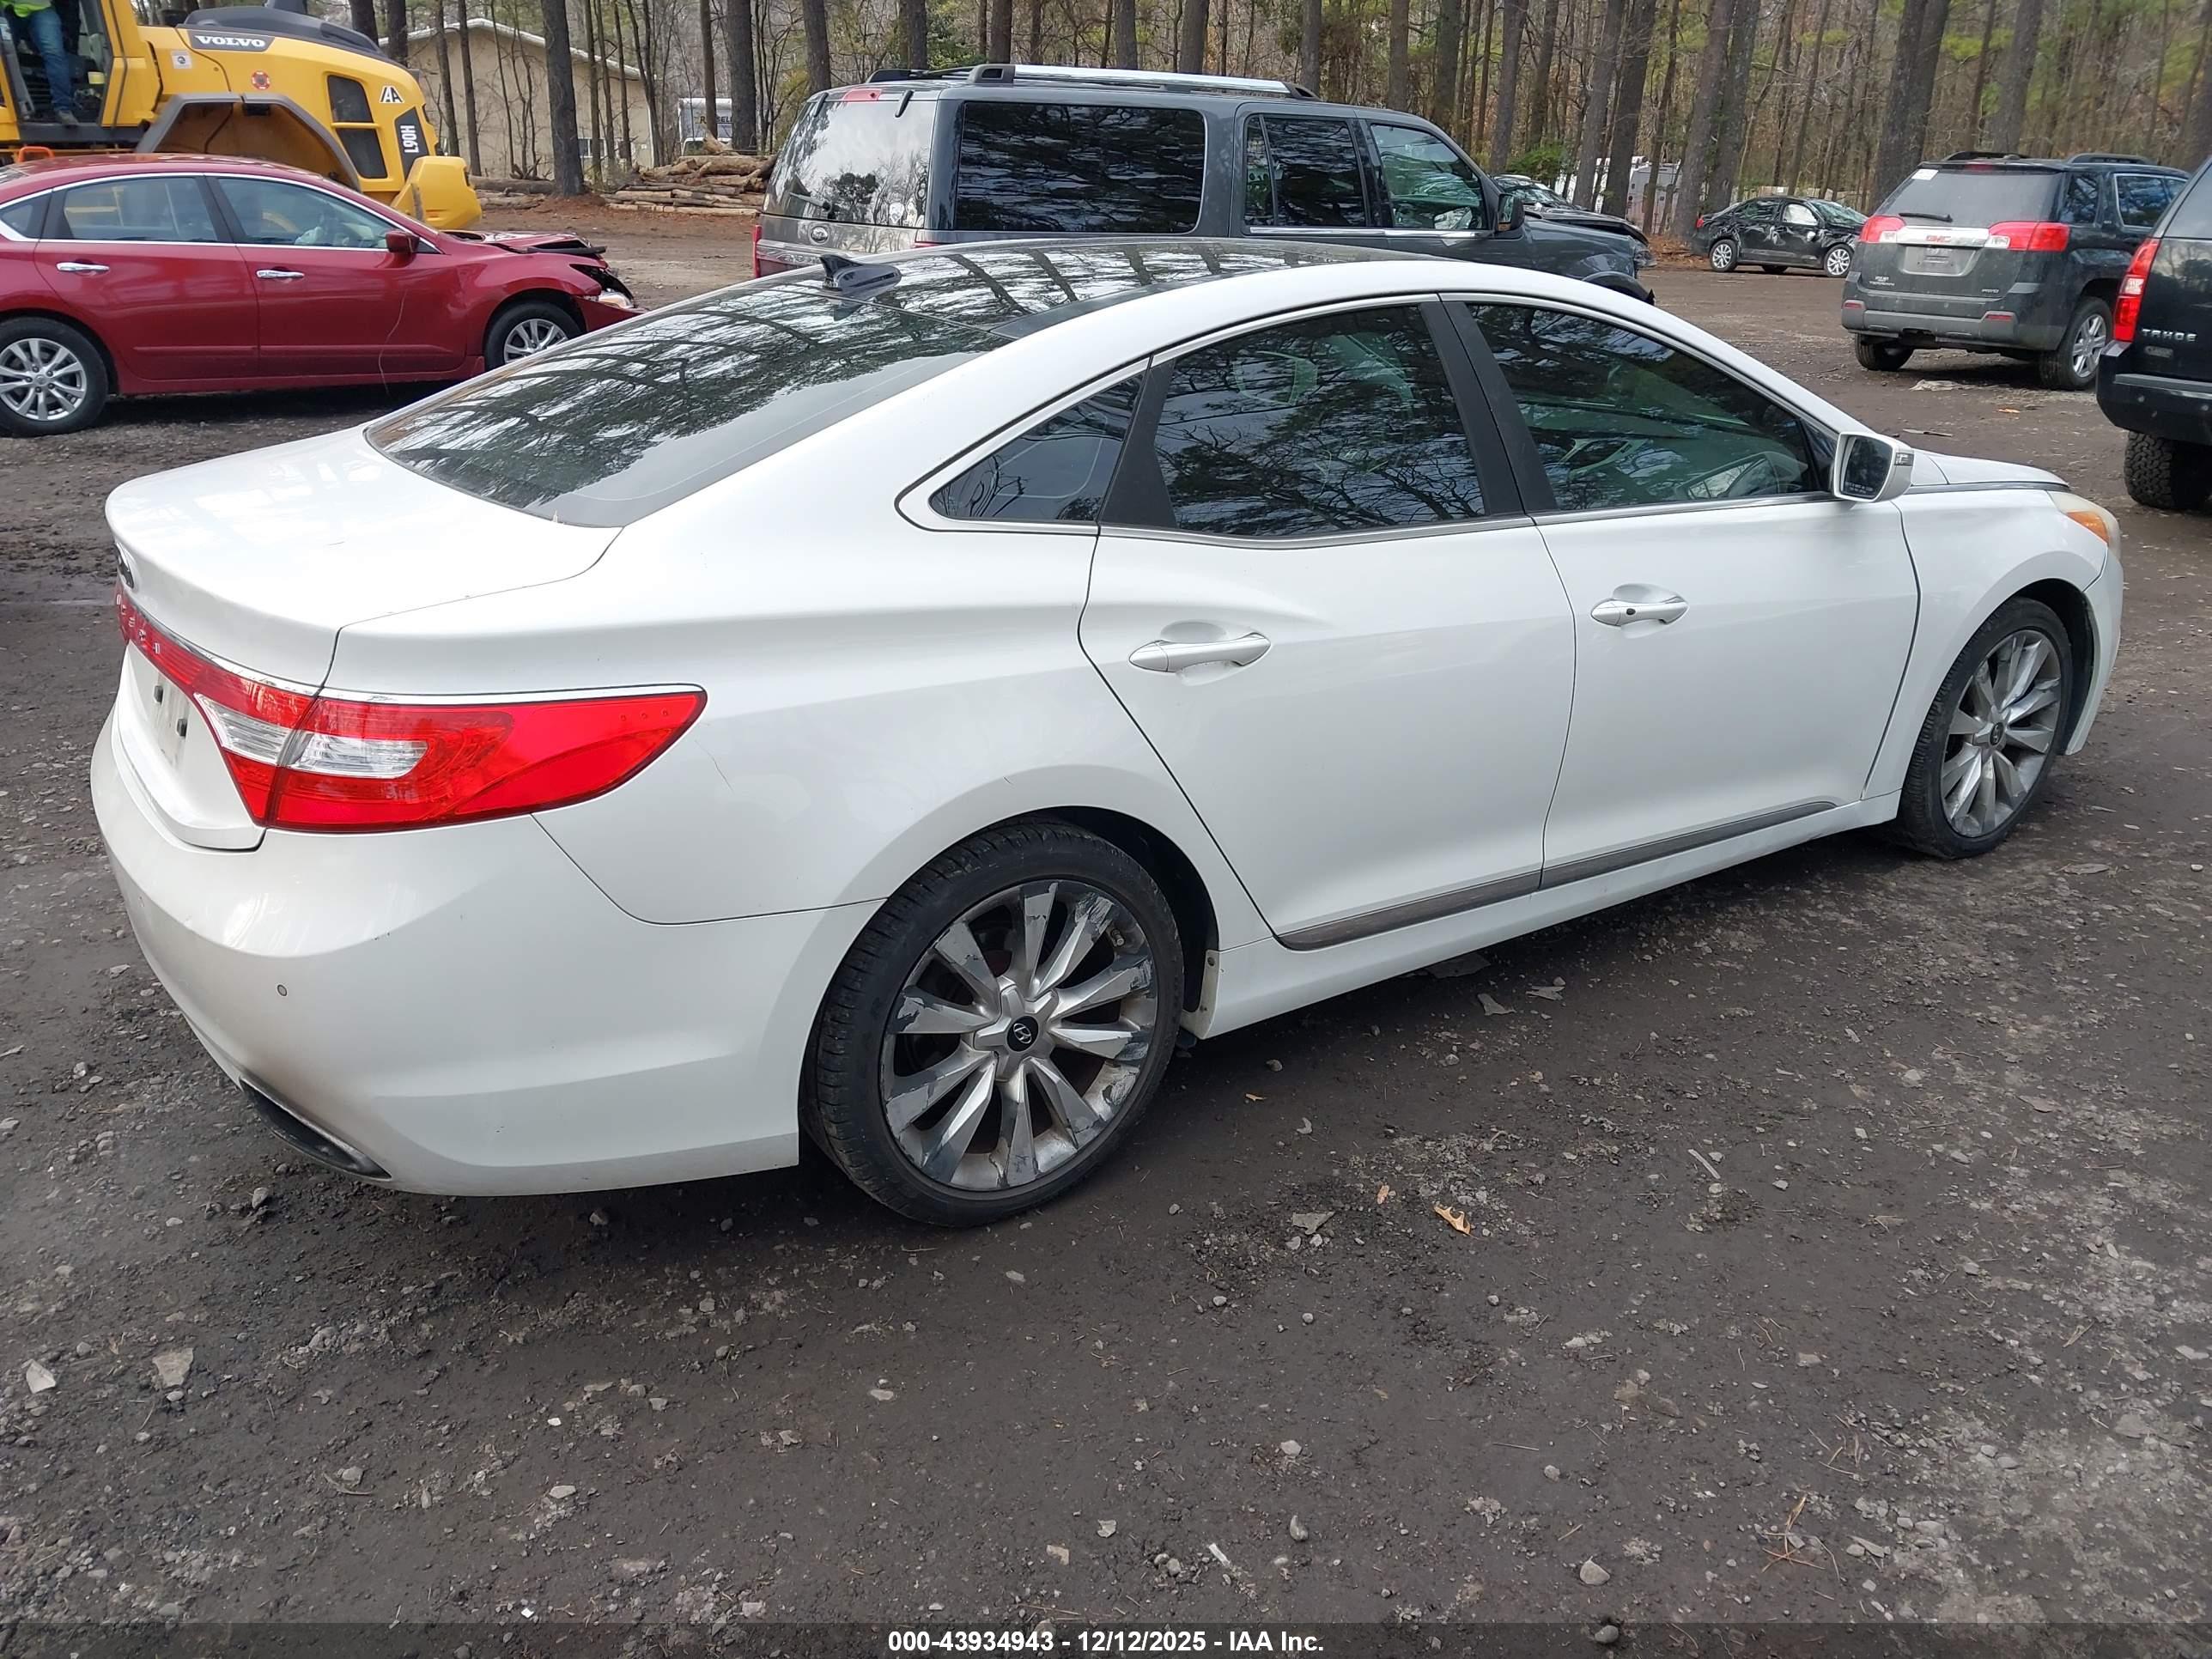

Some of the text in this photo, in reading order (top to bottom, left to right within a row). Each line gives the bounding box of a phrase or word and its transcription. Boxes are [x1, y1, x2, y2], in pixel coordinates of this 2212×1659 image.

[195, 34, 265, 48] VOLVO
[400, 125, 420, 154] L90H
[2142, 328, 2197, 342] TAHOE
